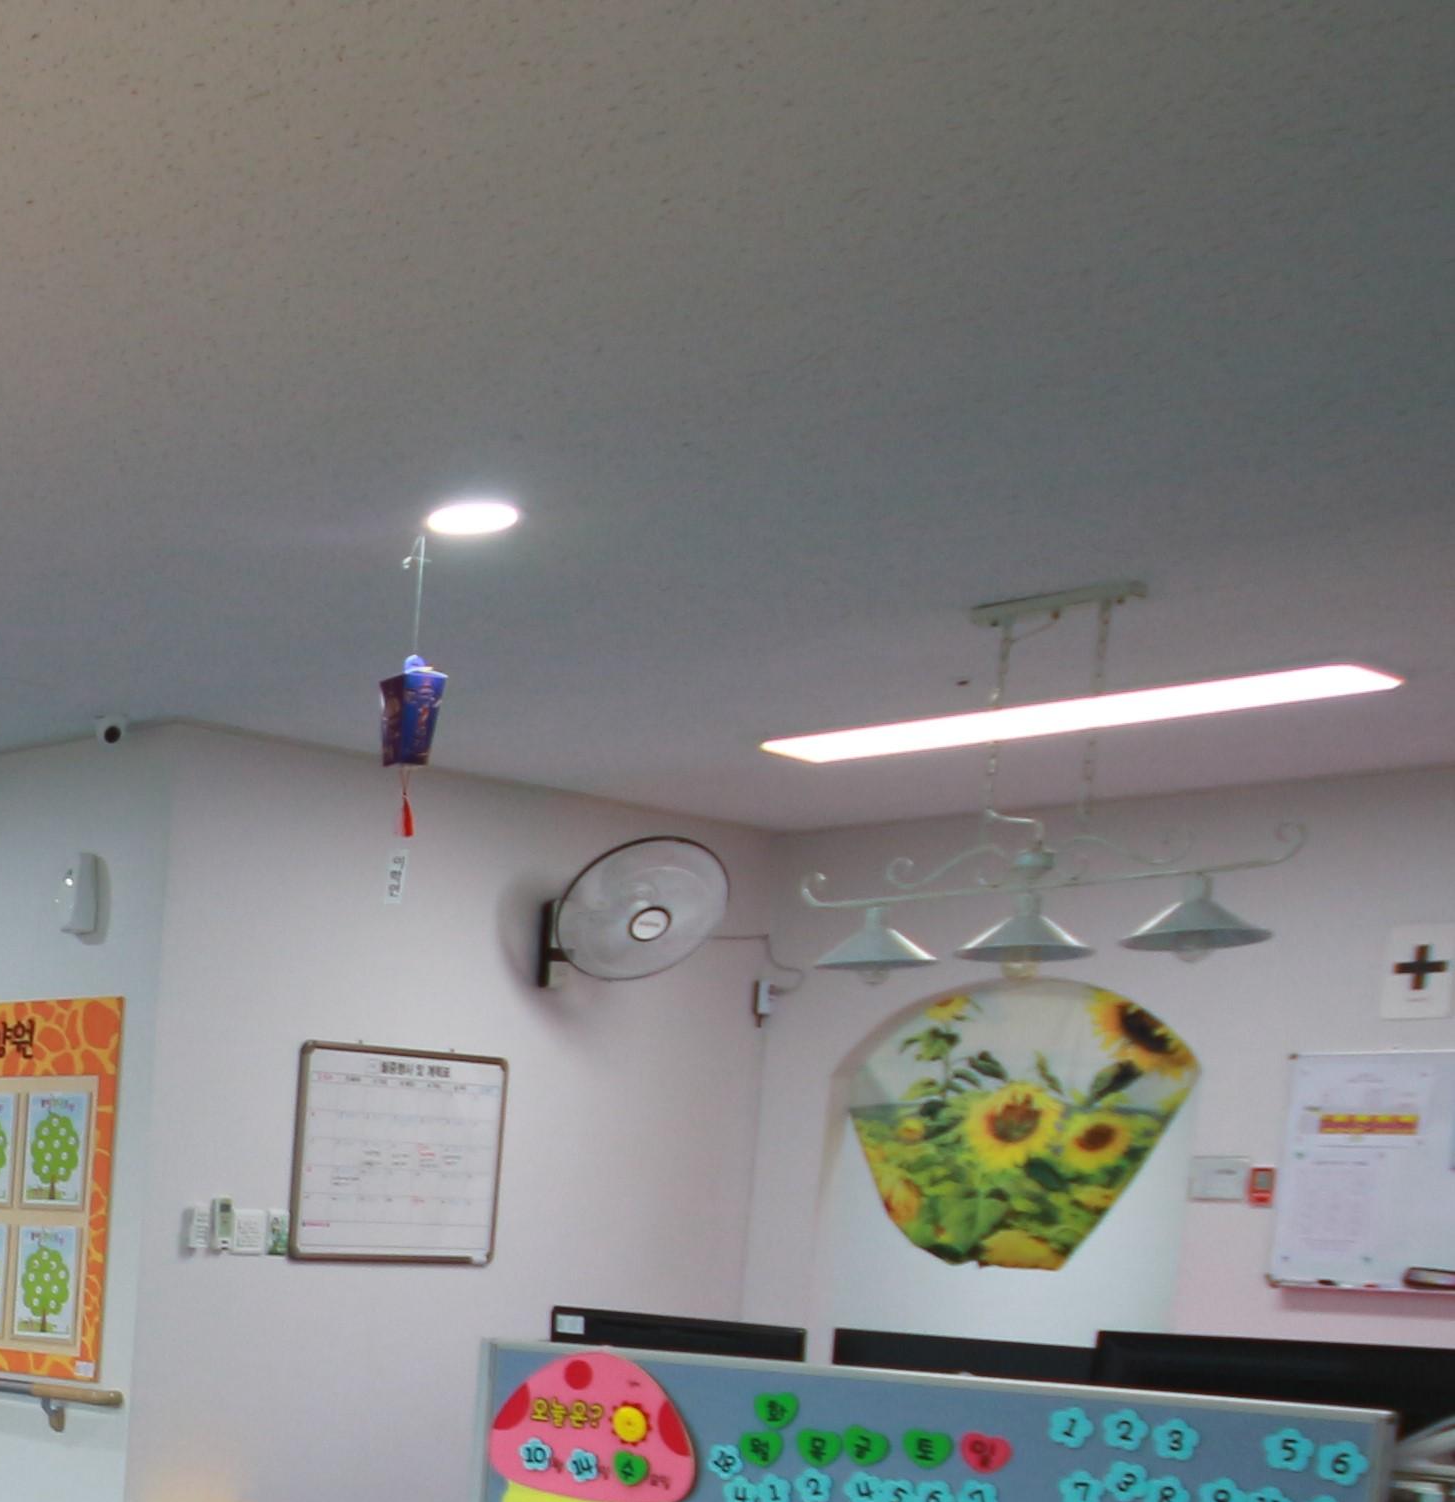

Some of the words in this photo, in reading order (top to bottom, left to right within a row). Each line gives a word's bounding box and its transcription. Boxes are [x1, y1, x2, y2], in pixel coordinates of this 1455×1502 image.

[1062, 1417, 1077, 1439] 1
[1116, 1420, 1134, 1442] 2
[1168, 1429, 1184, 1452] 3
[1280, 1437, 1299, 1462] 5
[1331, 1452, 1352, 1475] 6
[525, 1446, 547, 1464] 10
[571, 1457, 593, 1476] 14
[768, 1484, 782, 1501] 1
[806, 1477, 822, 1496] 2
[855, 1481, 874, 1499] 4
[1073, 1481, 1091, 1502] 7
